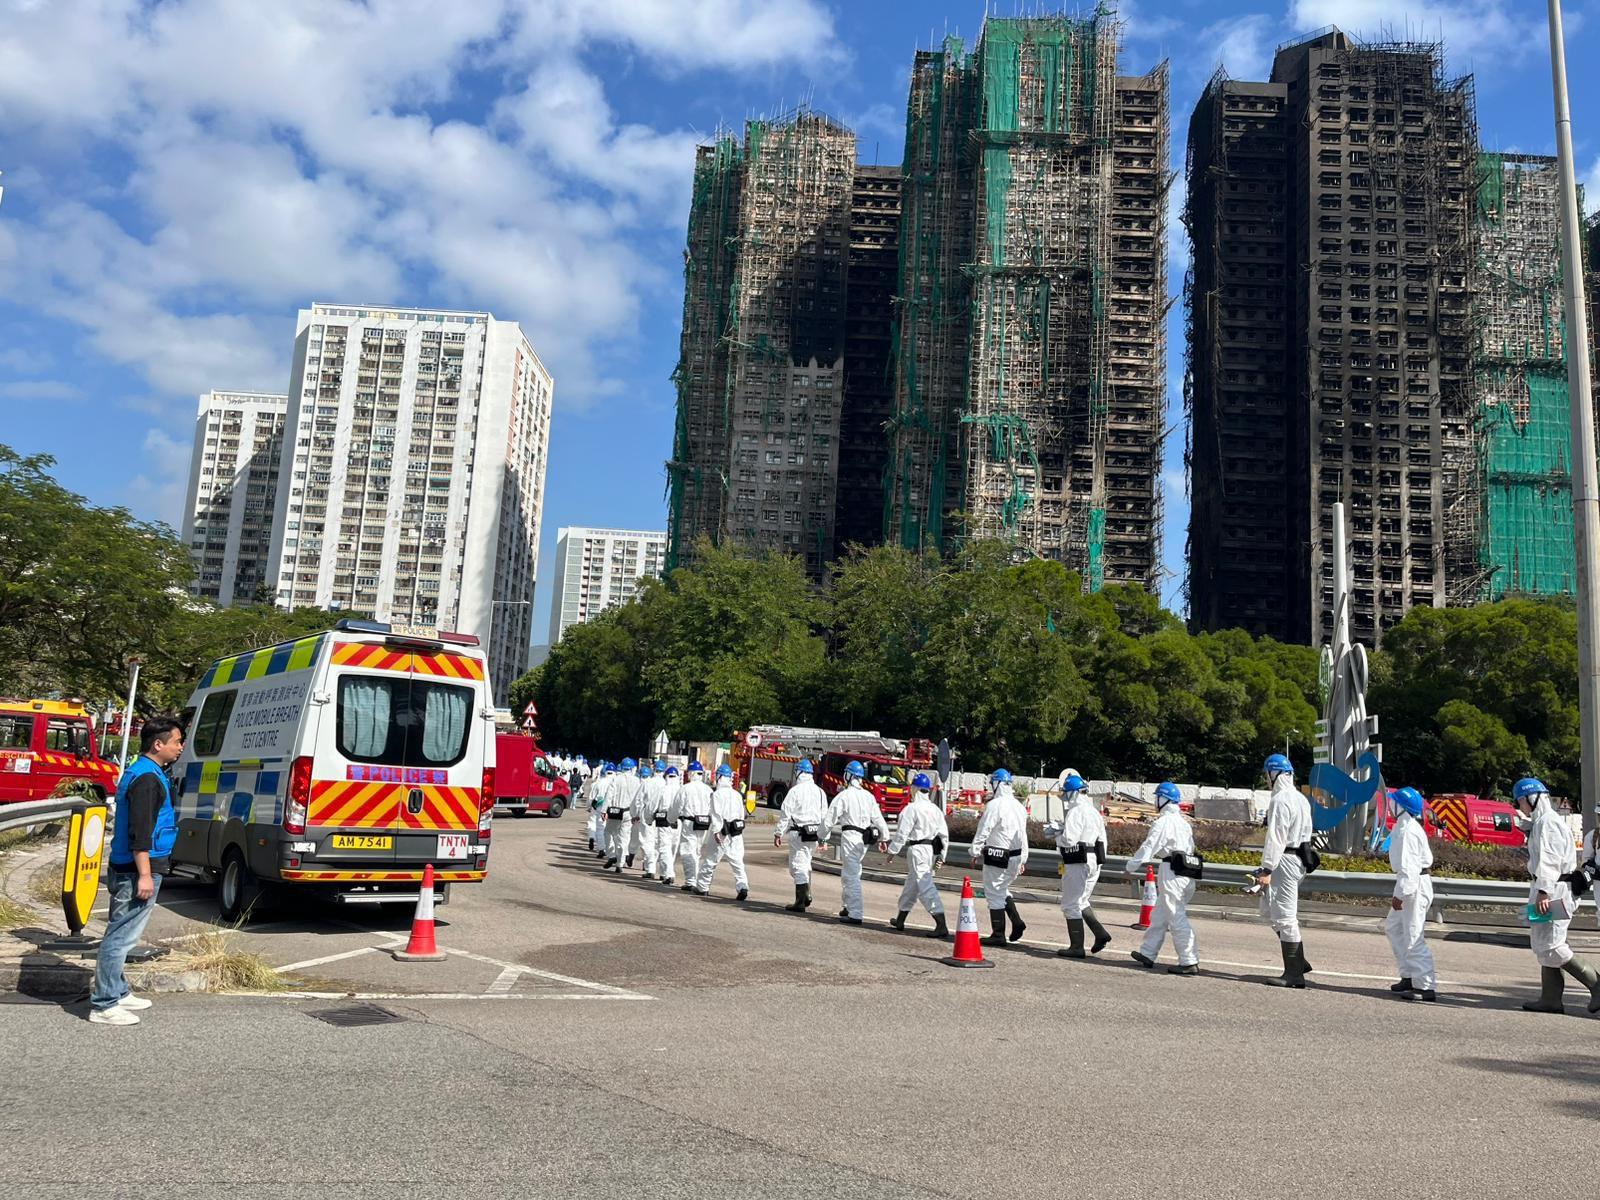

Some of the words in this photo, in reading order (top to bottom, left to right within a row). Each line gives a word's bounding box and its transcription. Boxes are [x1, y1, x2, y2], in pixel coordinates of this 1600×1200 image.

[234, 710, 256, 728] POLICE
[253, 707, 276, 726] MOBILE
[274, 704, 301, 723] BREATH
[242, 732, 257, 748] TEST
[254, 730, 280, 748] CENTRE
[369, 767, 428, 784] POLICE
[338, 836, 355, 847] AM
[359, 836, 386, 848] 7541
[439, 836, 467, 848] TNTN
[448, 847, 456, 858] 4
[987, 847, 1005, 858] DVIU
